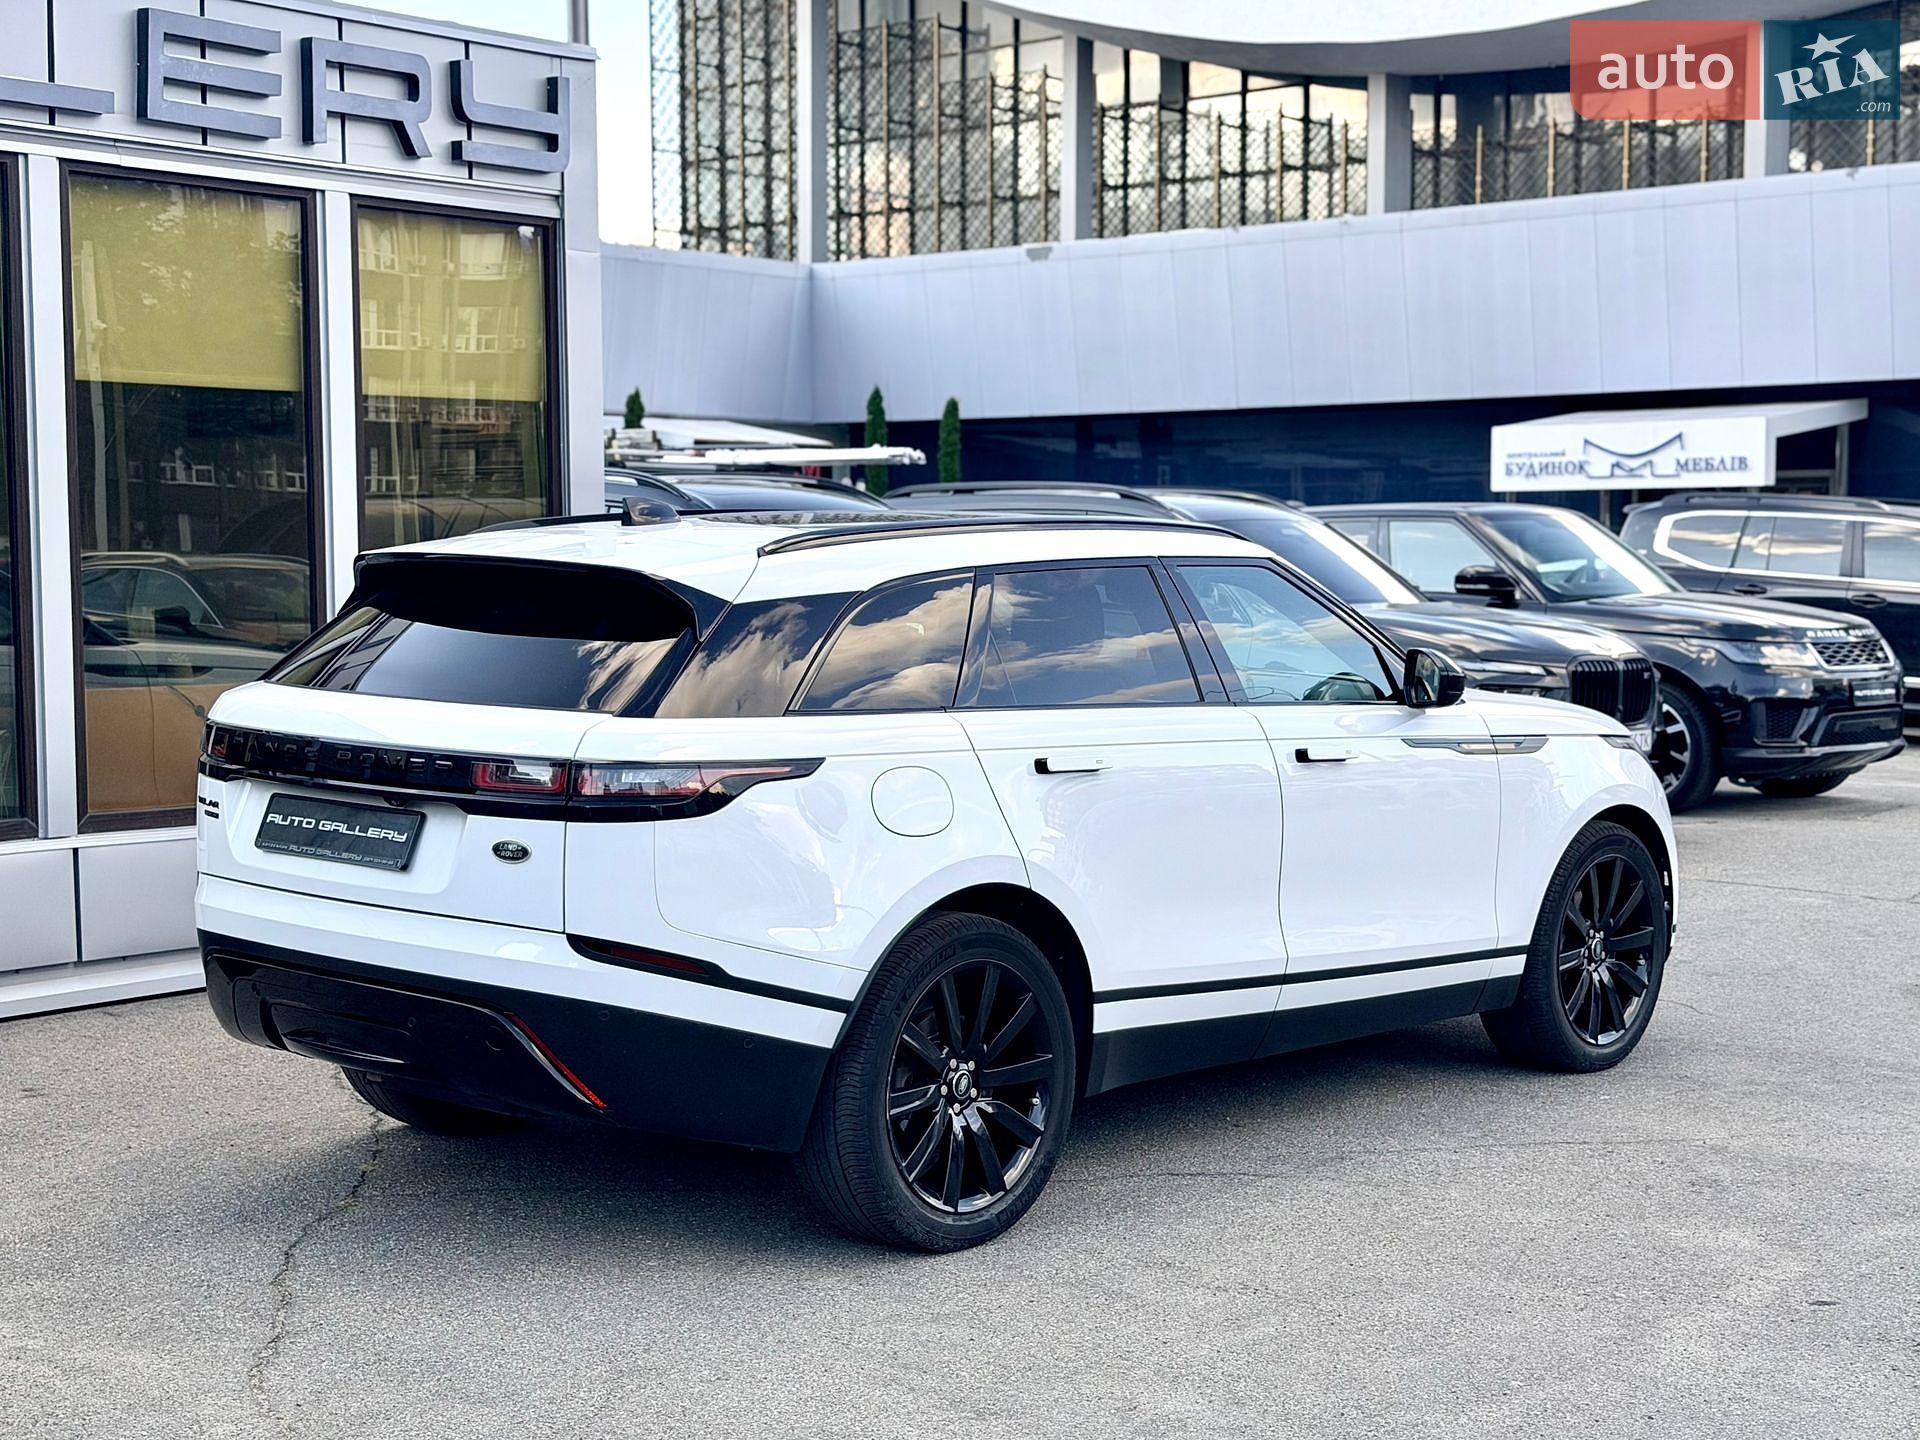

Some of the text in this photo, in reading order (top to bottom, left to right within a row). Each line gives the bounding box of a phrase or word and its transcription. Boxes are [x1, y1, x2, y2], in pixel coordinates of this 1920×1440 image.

[1504, 456, 1749, 478] БУДИНОК МЕБЛІВ
[265, 813, 408, 843] AUTO GALLERY
[288, 843, 315, 855] AUTO
[315, 848, 362, 862] GALLERY
[499, 843, 518, 851] LAND
[500, 850, 524, 858] ROVER
